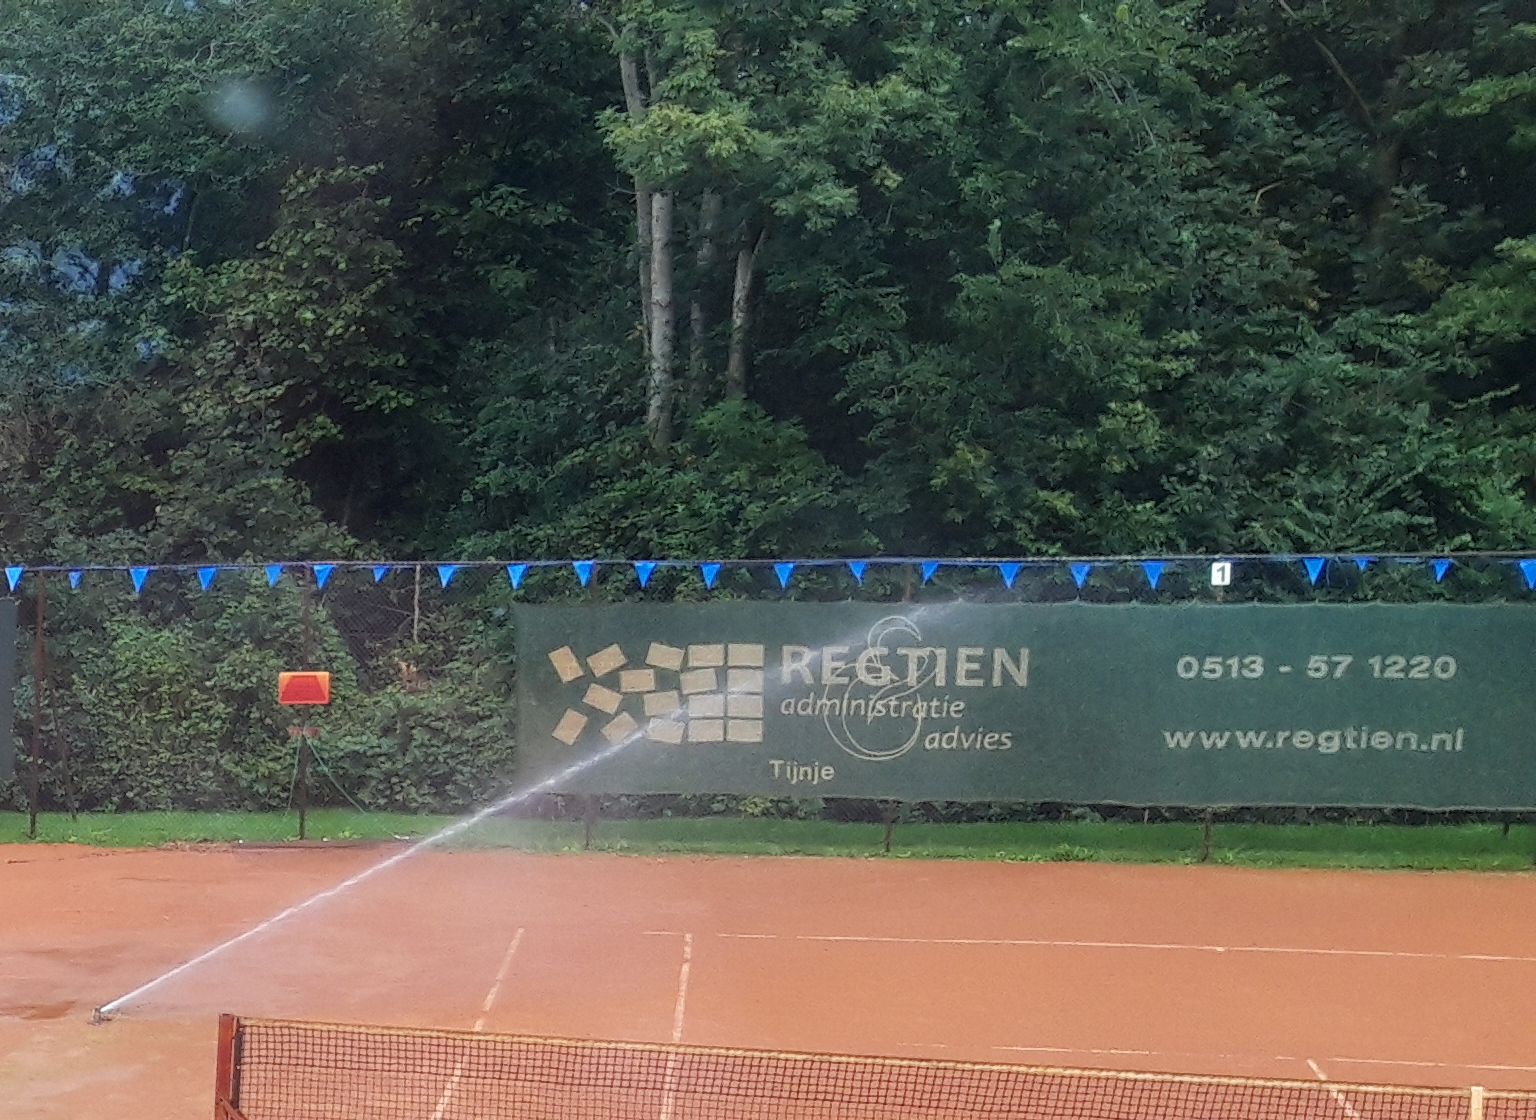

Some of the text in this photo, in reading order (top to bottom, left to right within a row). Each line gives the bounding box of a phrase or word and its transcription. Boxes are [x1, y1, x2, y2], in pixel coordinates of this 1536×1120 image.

[779, 645, 1031, 689] REGTIEN
[1176, 654, 1263, 681] 0513
[1308, 654, 1353, 680] 57
[1366, 654, 1458, 681] 1220
[779, 692, 965, 720] administratie
[924, 725, 1013, 752] advies
[1161, 724, 1466, 754] www.regtien.nl
[770, 759, 835, 785] Tijnje
